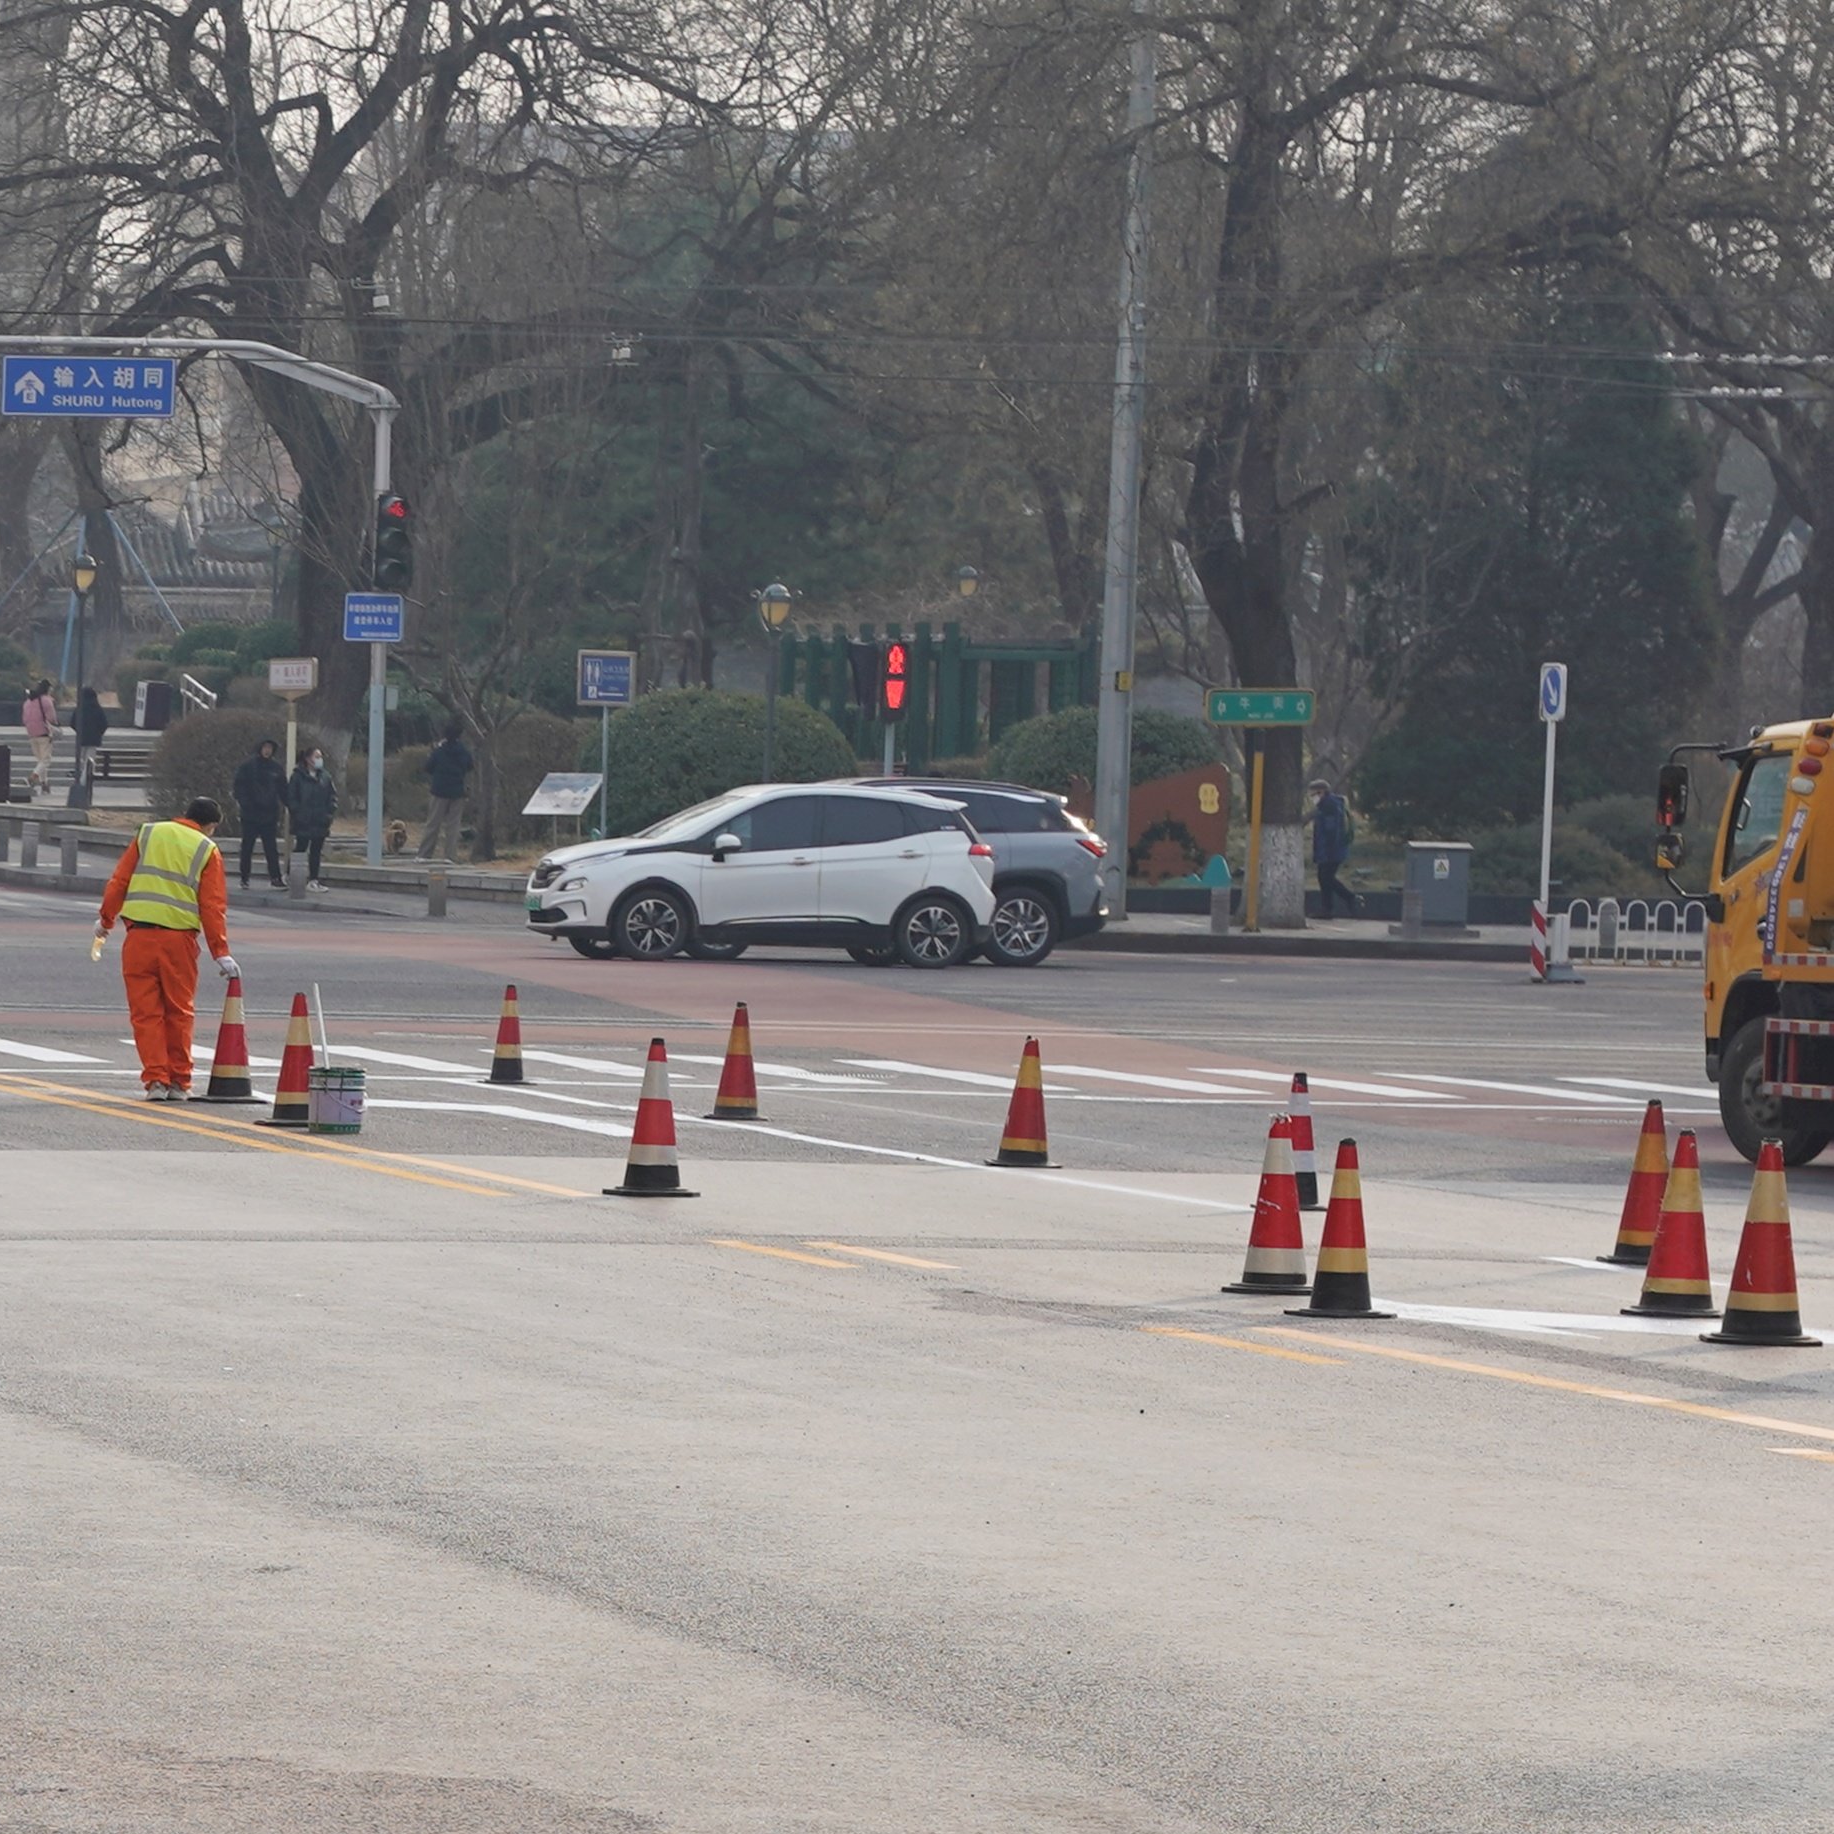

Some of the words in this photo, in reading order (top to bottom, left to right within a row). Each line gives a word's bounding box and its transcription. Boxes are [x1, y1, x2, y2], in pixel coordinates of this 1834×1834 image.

[53, 366, 163, 388] 输入胡同
[52, 395, 104, 407] SHURU
[112, 397, 163, 410] Hutong
